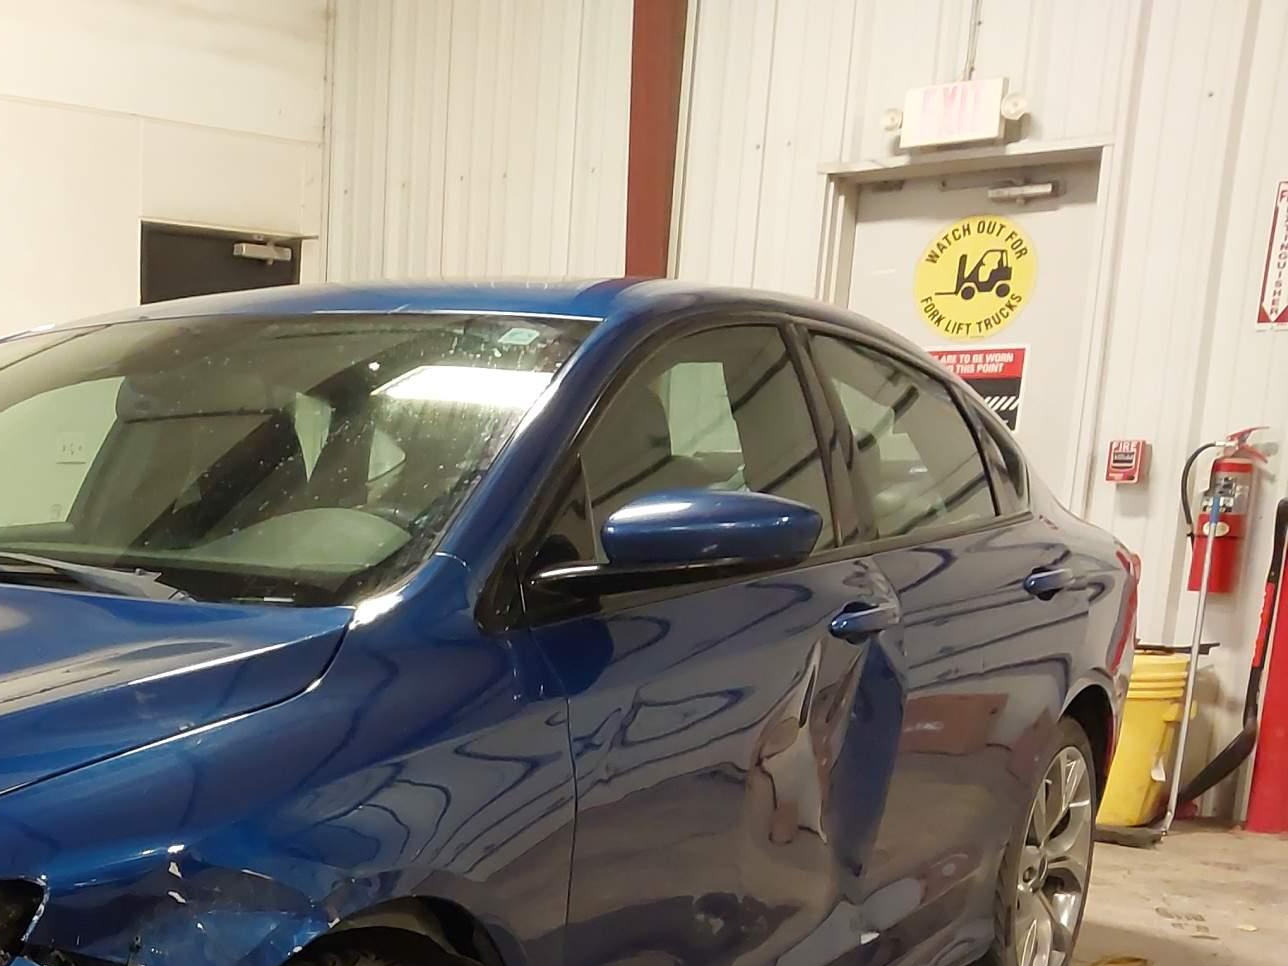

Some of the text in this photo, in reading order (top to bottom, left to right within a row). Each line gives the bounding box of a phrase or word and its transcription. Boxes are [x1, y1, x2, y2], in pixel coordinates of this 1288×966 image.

[925, 220, 1028, 264] WATCH OUT FOR
[920, 293, 1022, 335] FORK LIFT TRUCKS
[941, 354, 957, 364] ARE
[959, 354, 971, 364] TO
[972, 353, 985, 363] BE
[985, 352, 1014, 363] WORN
[955, 364, 976, 374] THIS
[976, 363, 1005, 373] POINT
[1112, 440, 1138, 452] FIRE
